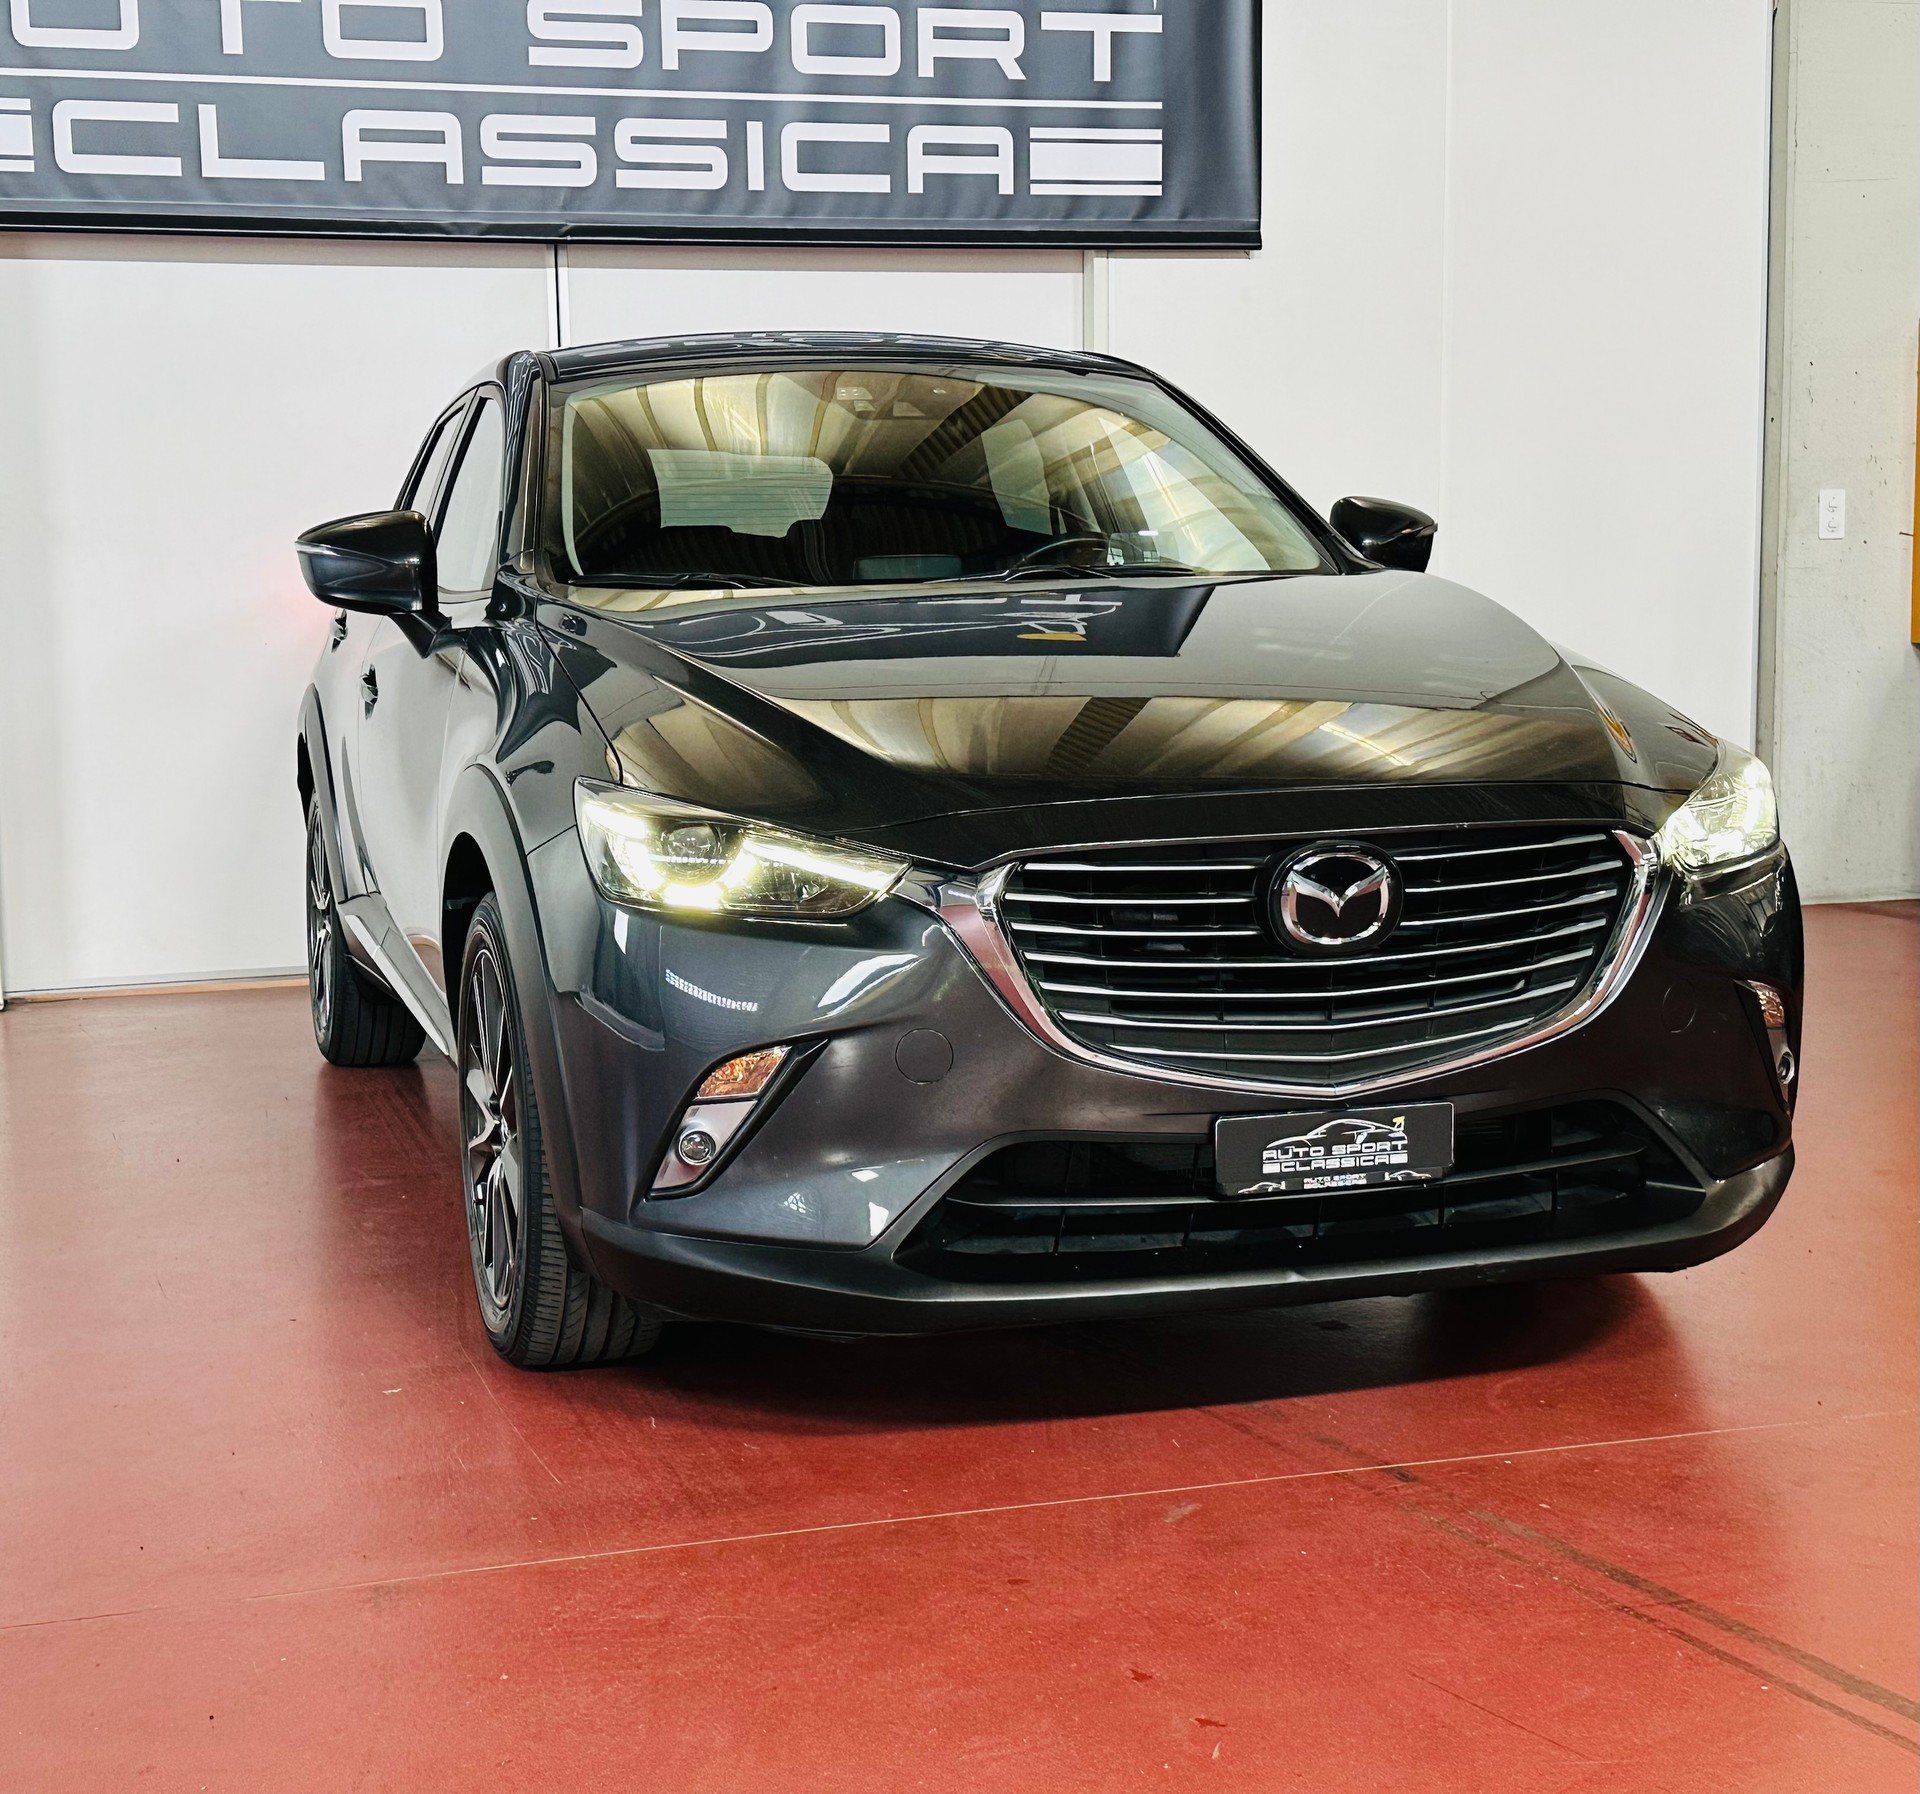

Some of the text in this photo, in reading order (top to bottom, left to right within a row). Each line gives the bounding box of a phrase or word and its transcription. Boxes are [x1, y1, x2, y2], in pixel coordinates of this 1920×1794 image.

[527, 0, 1163, 82] SPORT
[53, 99, 1014, 195] CLASSICA
[1262, 1140, 1408, 1160] AUTO SPORT
[1281, 1154, 1389, 1172] CLASSICA
